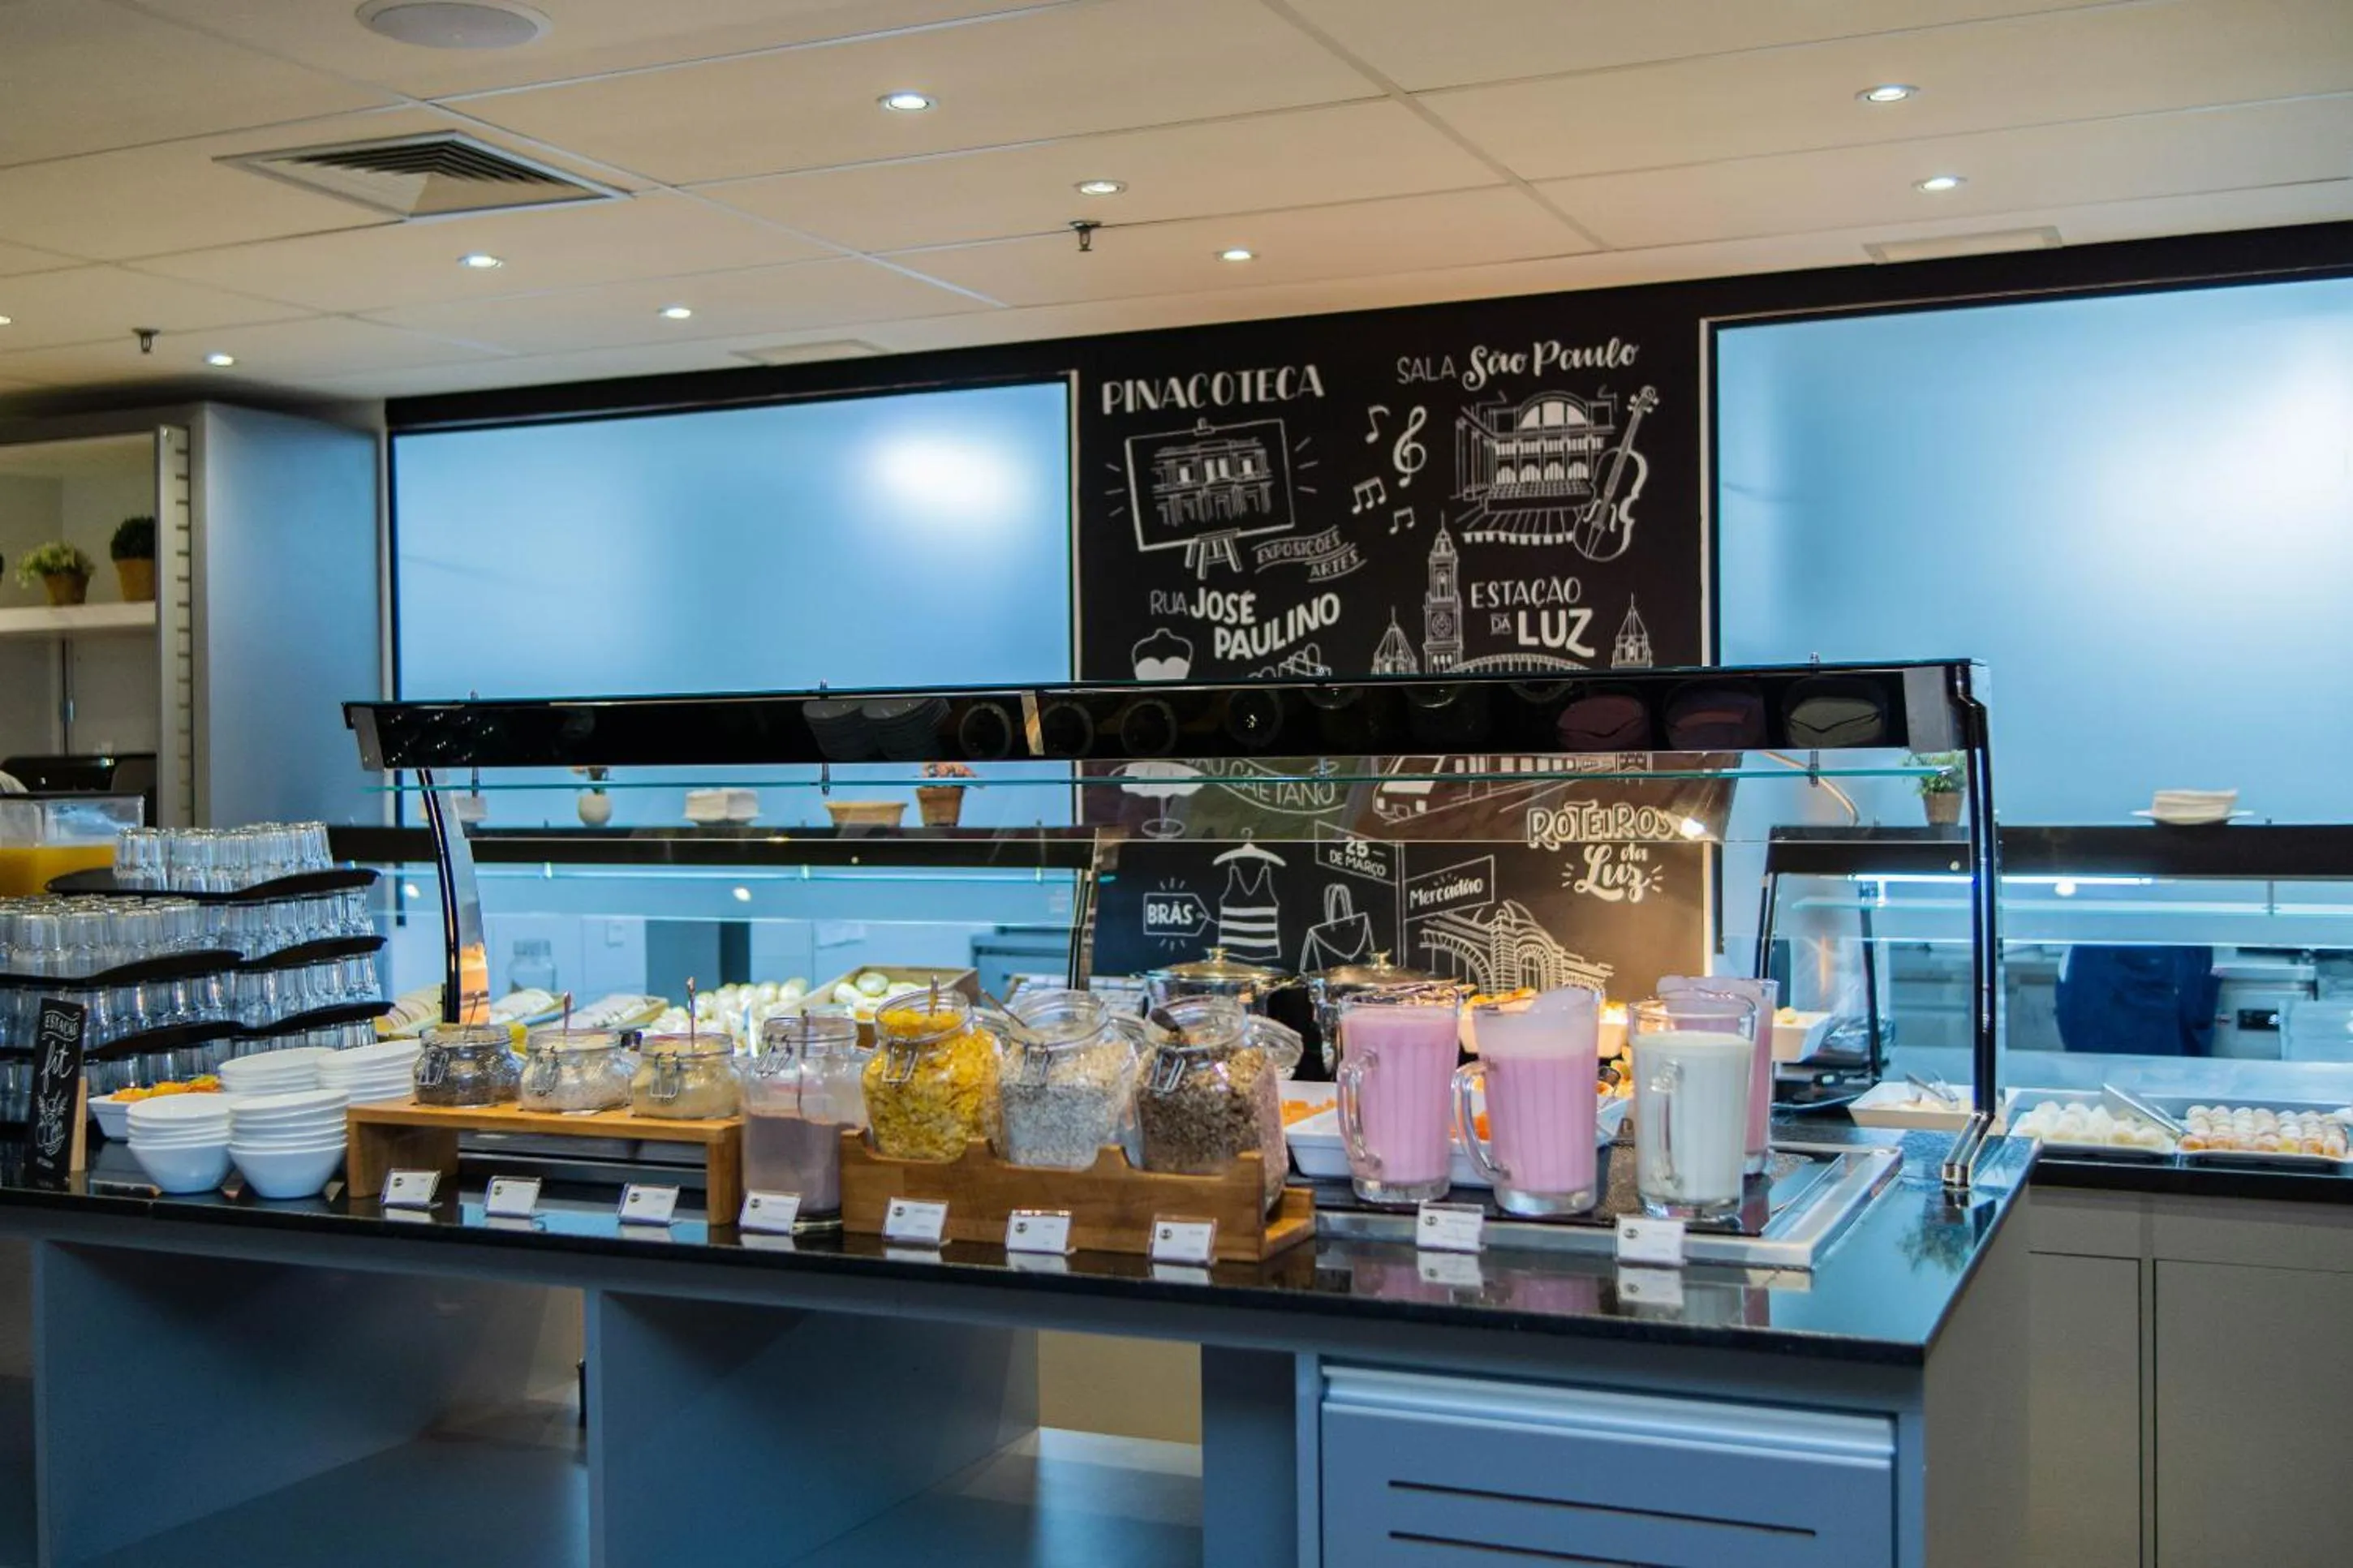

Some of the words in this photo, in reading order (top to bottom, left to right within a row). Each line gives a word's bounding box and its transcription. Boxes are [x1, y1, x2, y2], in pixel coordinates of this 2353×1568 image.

[1396, 355, 1457, 384] SALA
[1533, 337, 1641, 377] Paulo
[1102, 364, 1325, 415] PINACOTECA
[1310, 549, 1359, 578] ARTES
[1149, 589, 1188, 616] RUA
[1214, 592, 1341, 660] PAULINO
[1491, 614, 1512, 634] DA
[1517, 608, 1596, 658] LUZ
[1344, 836, 1370, 858] 25
[1527, 799, 1675, 852] ROTEIROS
[1329, 848, 1344, 866] DE
[1573, 844, 1652, 903] Luz
